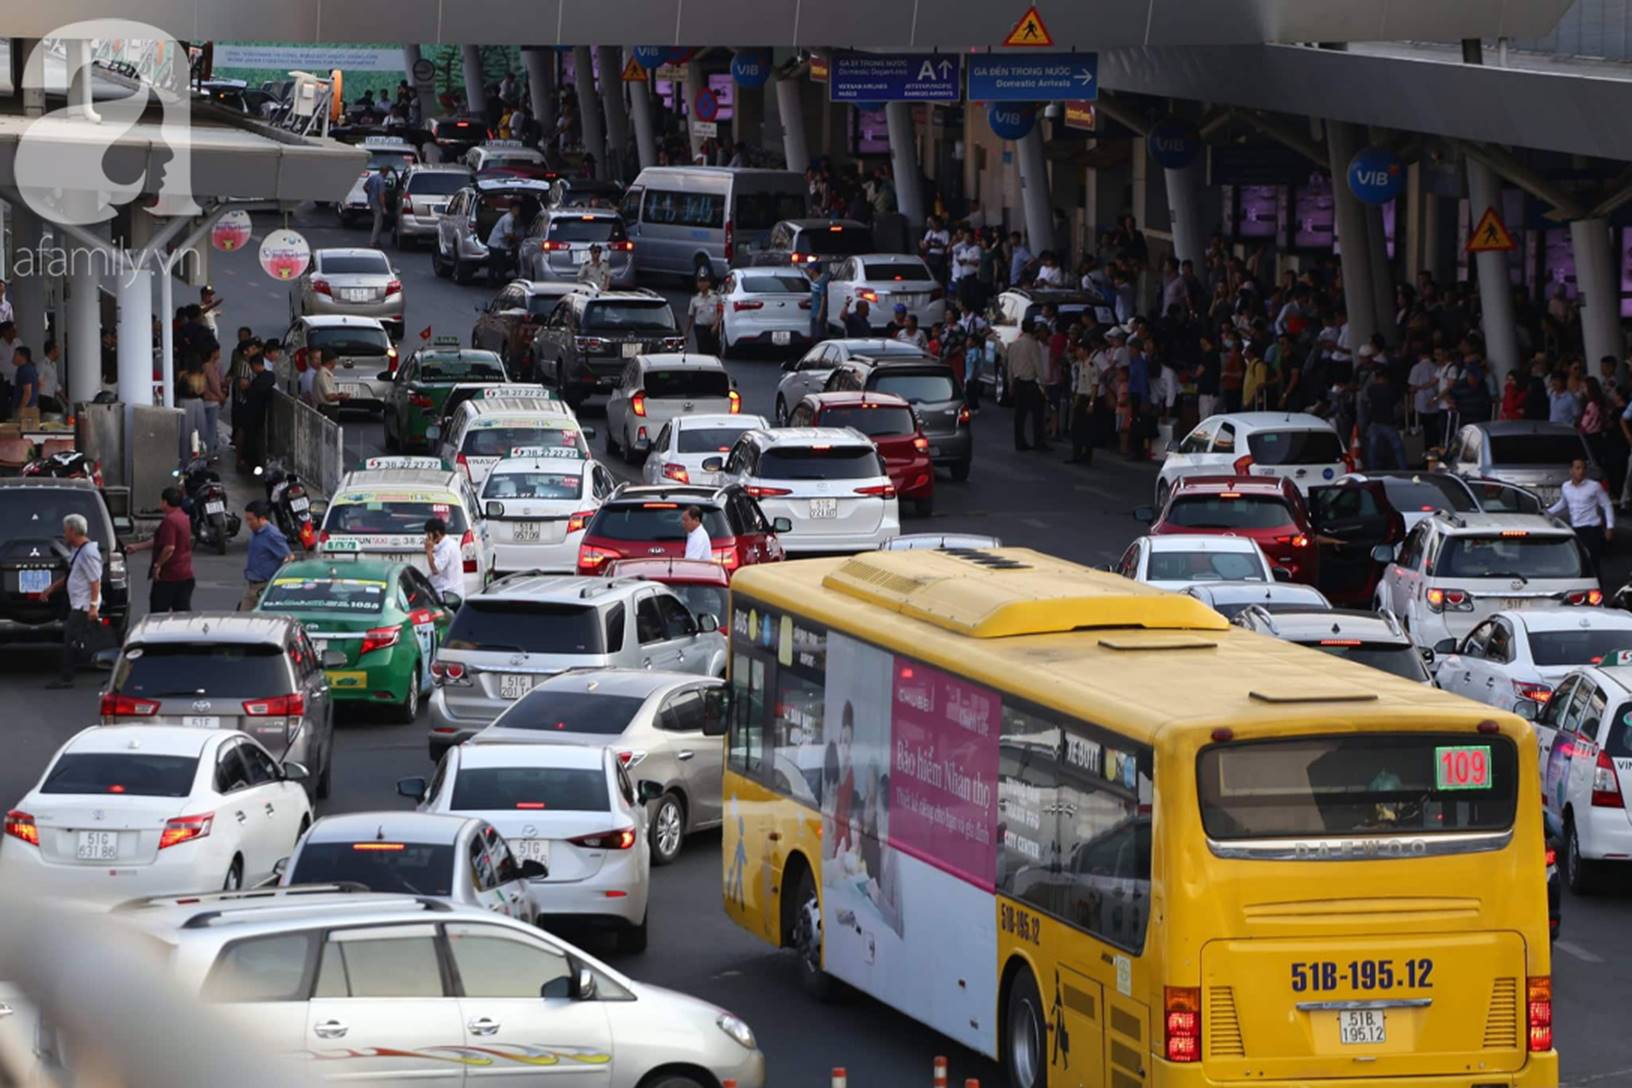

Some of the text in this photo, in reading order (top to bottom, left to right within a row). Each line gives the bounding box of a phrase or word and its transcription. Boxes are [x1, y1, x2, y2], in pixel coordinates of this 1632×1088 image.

[737, 64, 759, 75] VIB
[917, 60, 936, 80] A
[974, 67, 987, 76] GA
[1011, 66, 1043, 76] TRONG
[996, 79, 1071, 88] Domestic Arrivals
[995, 110, 1021, 126] VIB
[1357, 170, 1389, 186] VIB
[1442, 751, 1486, 785] 109
[897, 739, 991, 816] Bảo hiểm Nhân thọ
[88, 833, 109, 845] 51G
[1295, 839, 1426, 855] DAEWOO
[520, 841, 540, 854] 51G
[1018, 835, 1040, 860] CENTER
[1002, 903, 1040, 946] 51B-195.12
[1291, 959, 1434, 992] 51B-195.12
[1343, 1027, 1384, 1042] 195.12
